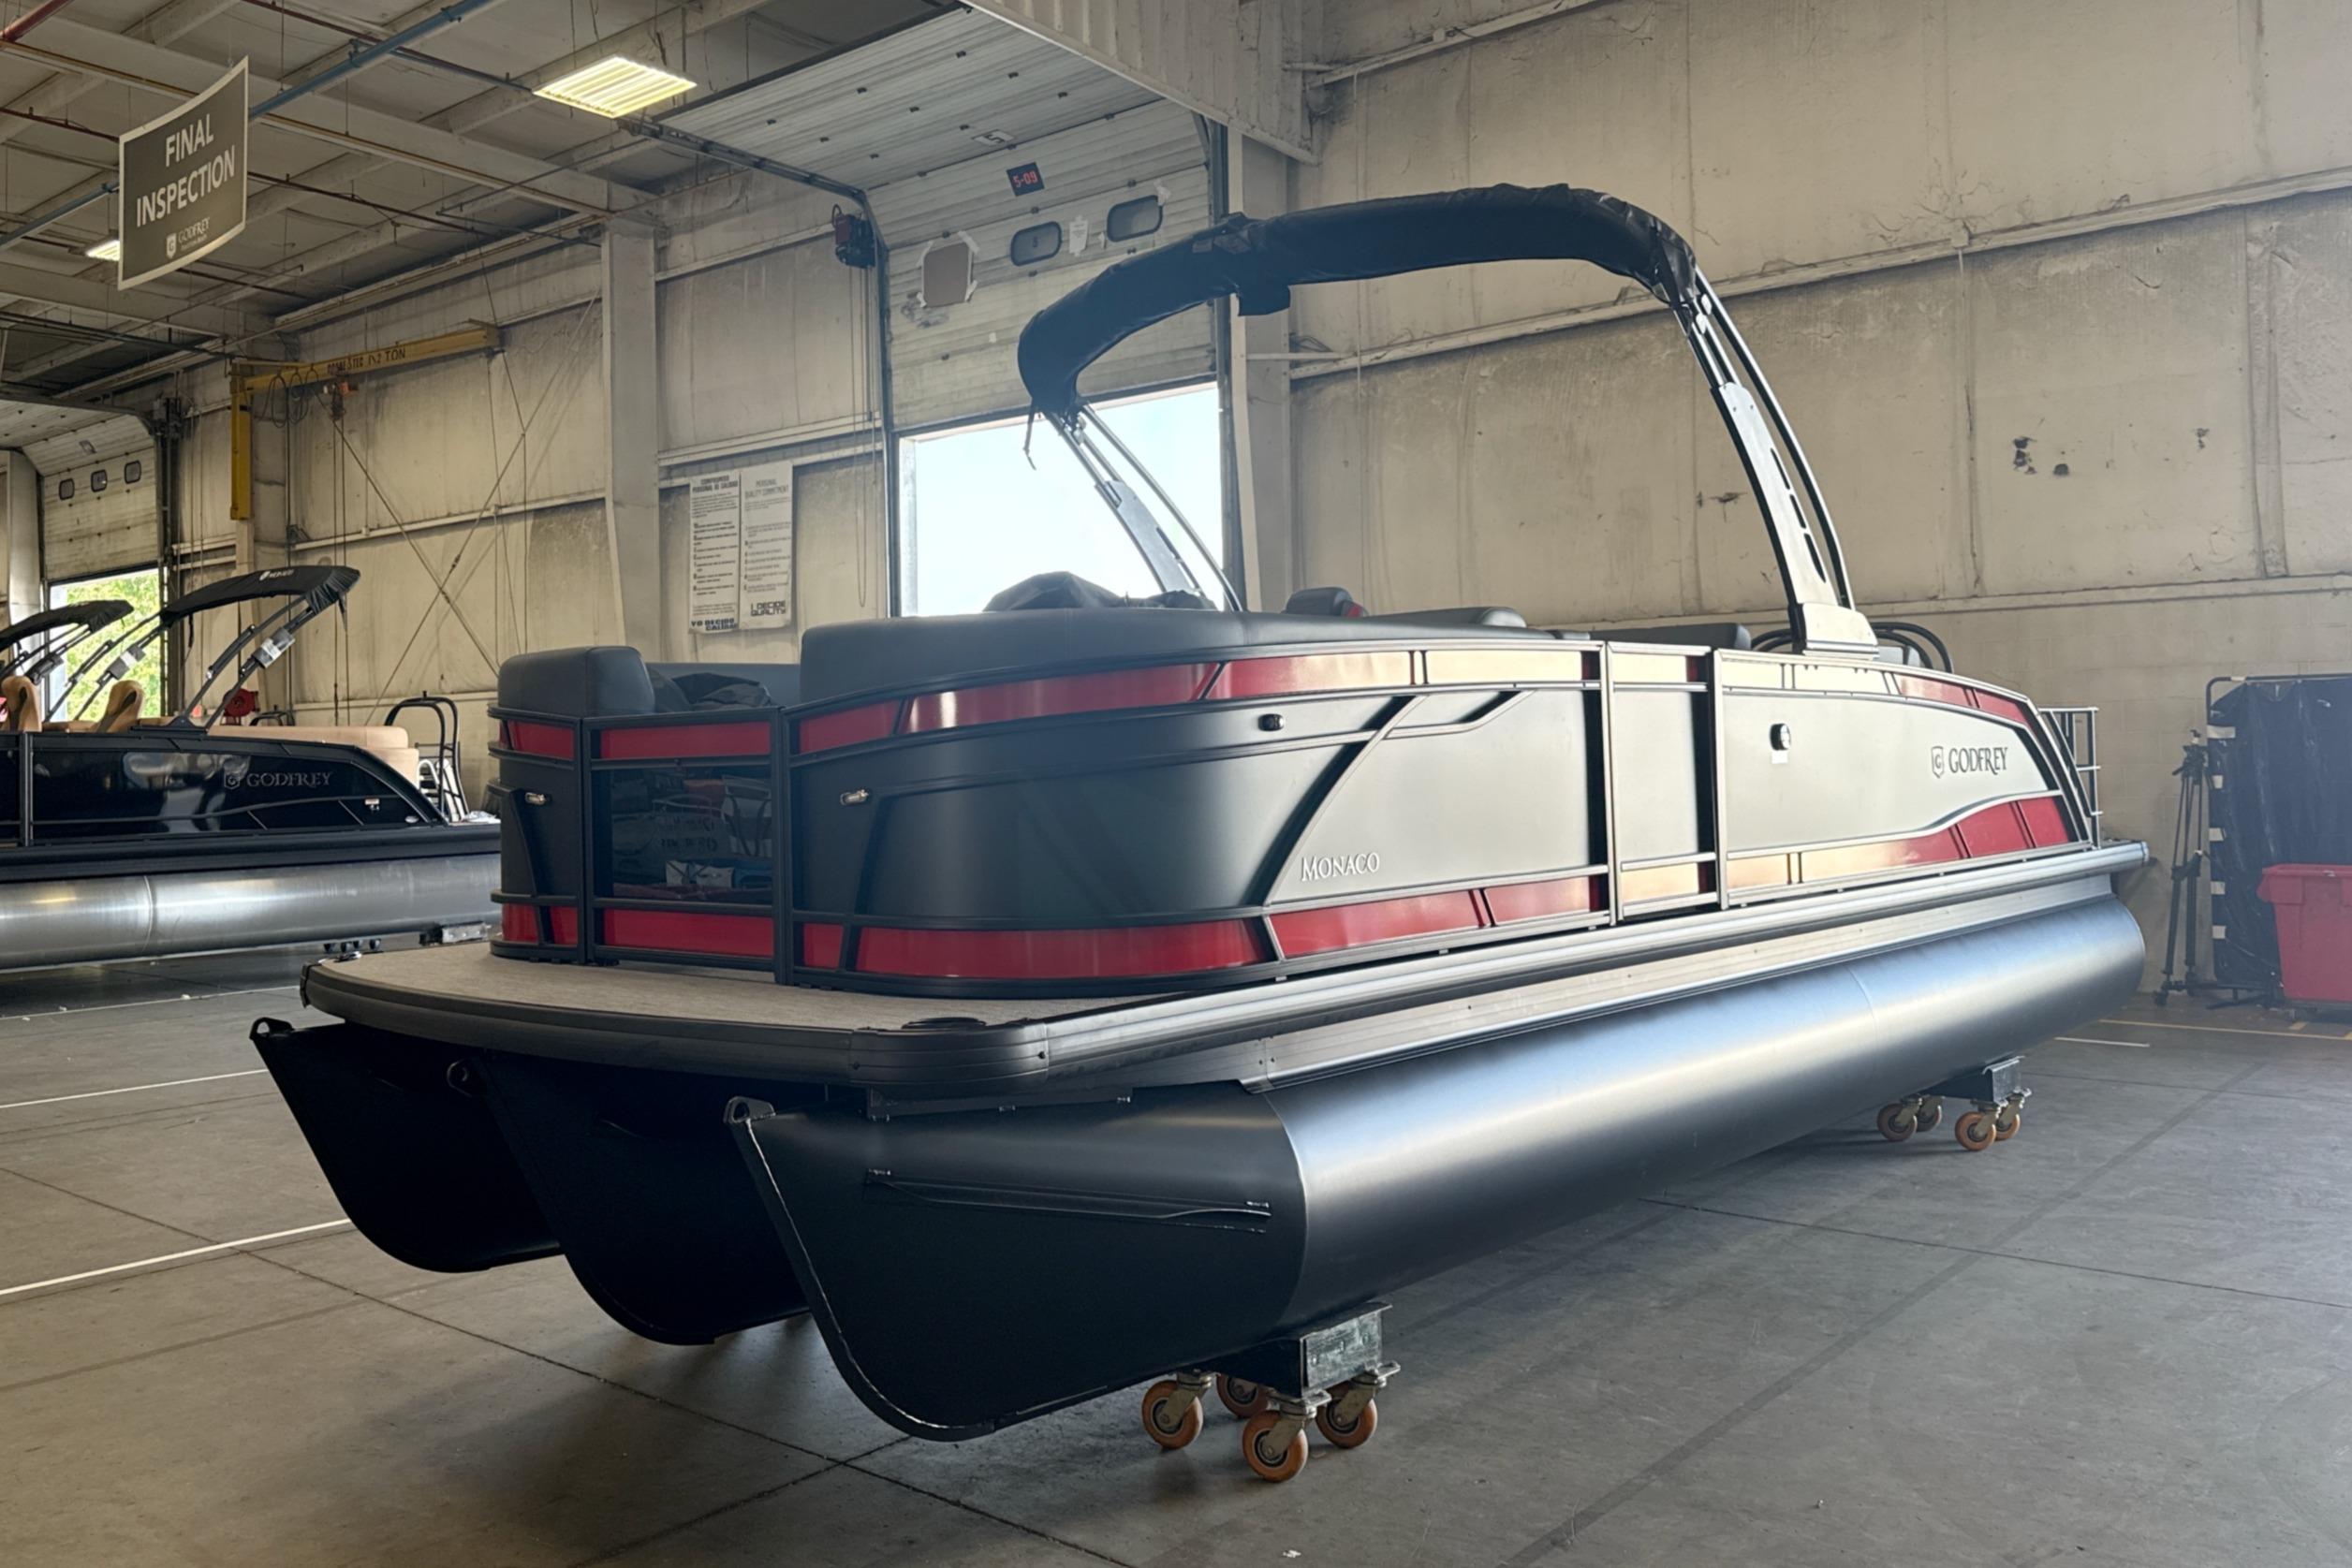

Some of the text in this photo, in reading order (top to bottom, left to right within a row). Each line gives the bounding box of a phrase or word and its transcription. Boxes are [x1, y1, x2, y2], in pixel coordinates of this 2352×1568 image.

[166, 114, 213, 167] FINAL
[137, 145, 235, 227] INSPECTION
[385, 347, 405, 361] TON
[1948, 747, 2008, 775] GODFREY
[246, 772, 332, 788] GODFREY
[1301, 852, 1380, 882] MONACO
